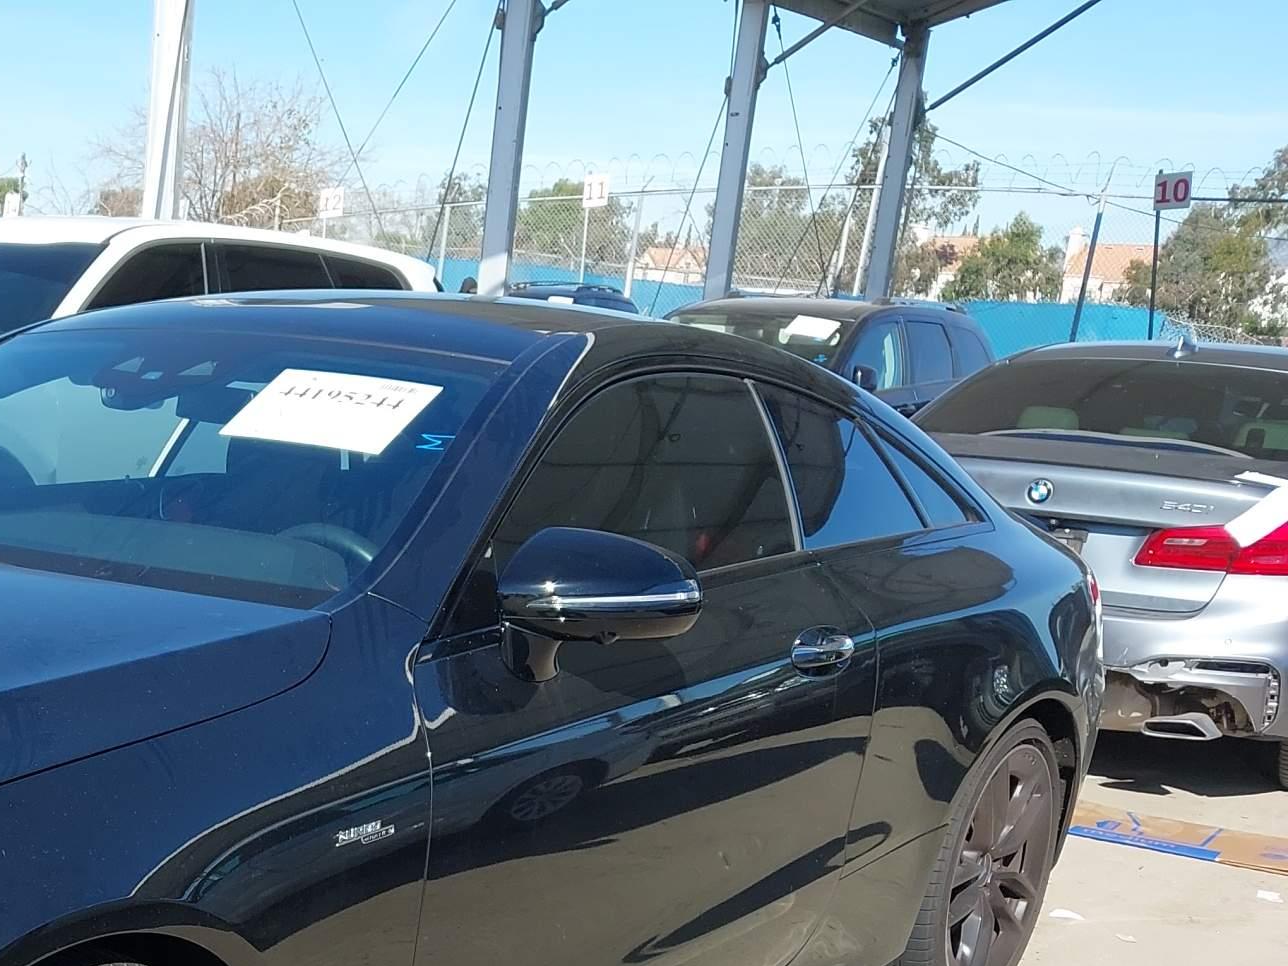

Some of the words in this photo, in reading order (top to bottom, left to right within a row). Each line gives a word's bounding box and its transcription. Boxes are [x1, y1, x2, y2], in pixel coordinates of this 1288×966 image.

[585, 182, 605, 200] 11
[1155, 178, 1190, 203] 10
[279, 385, 405, 410] 44195244
